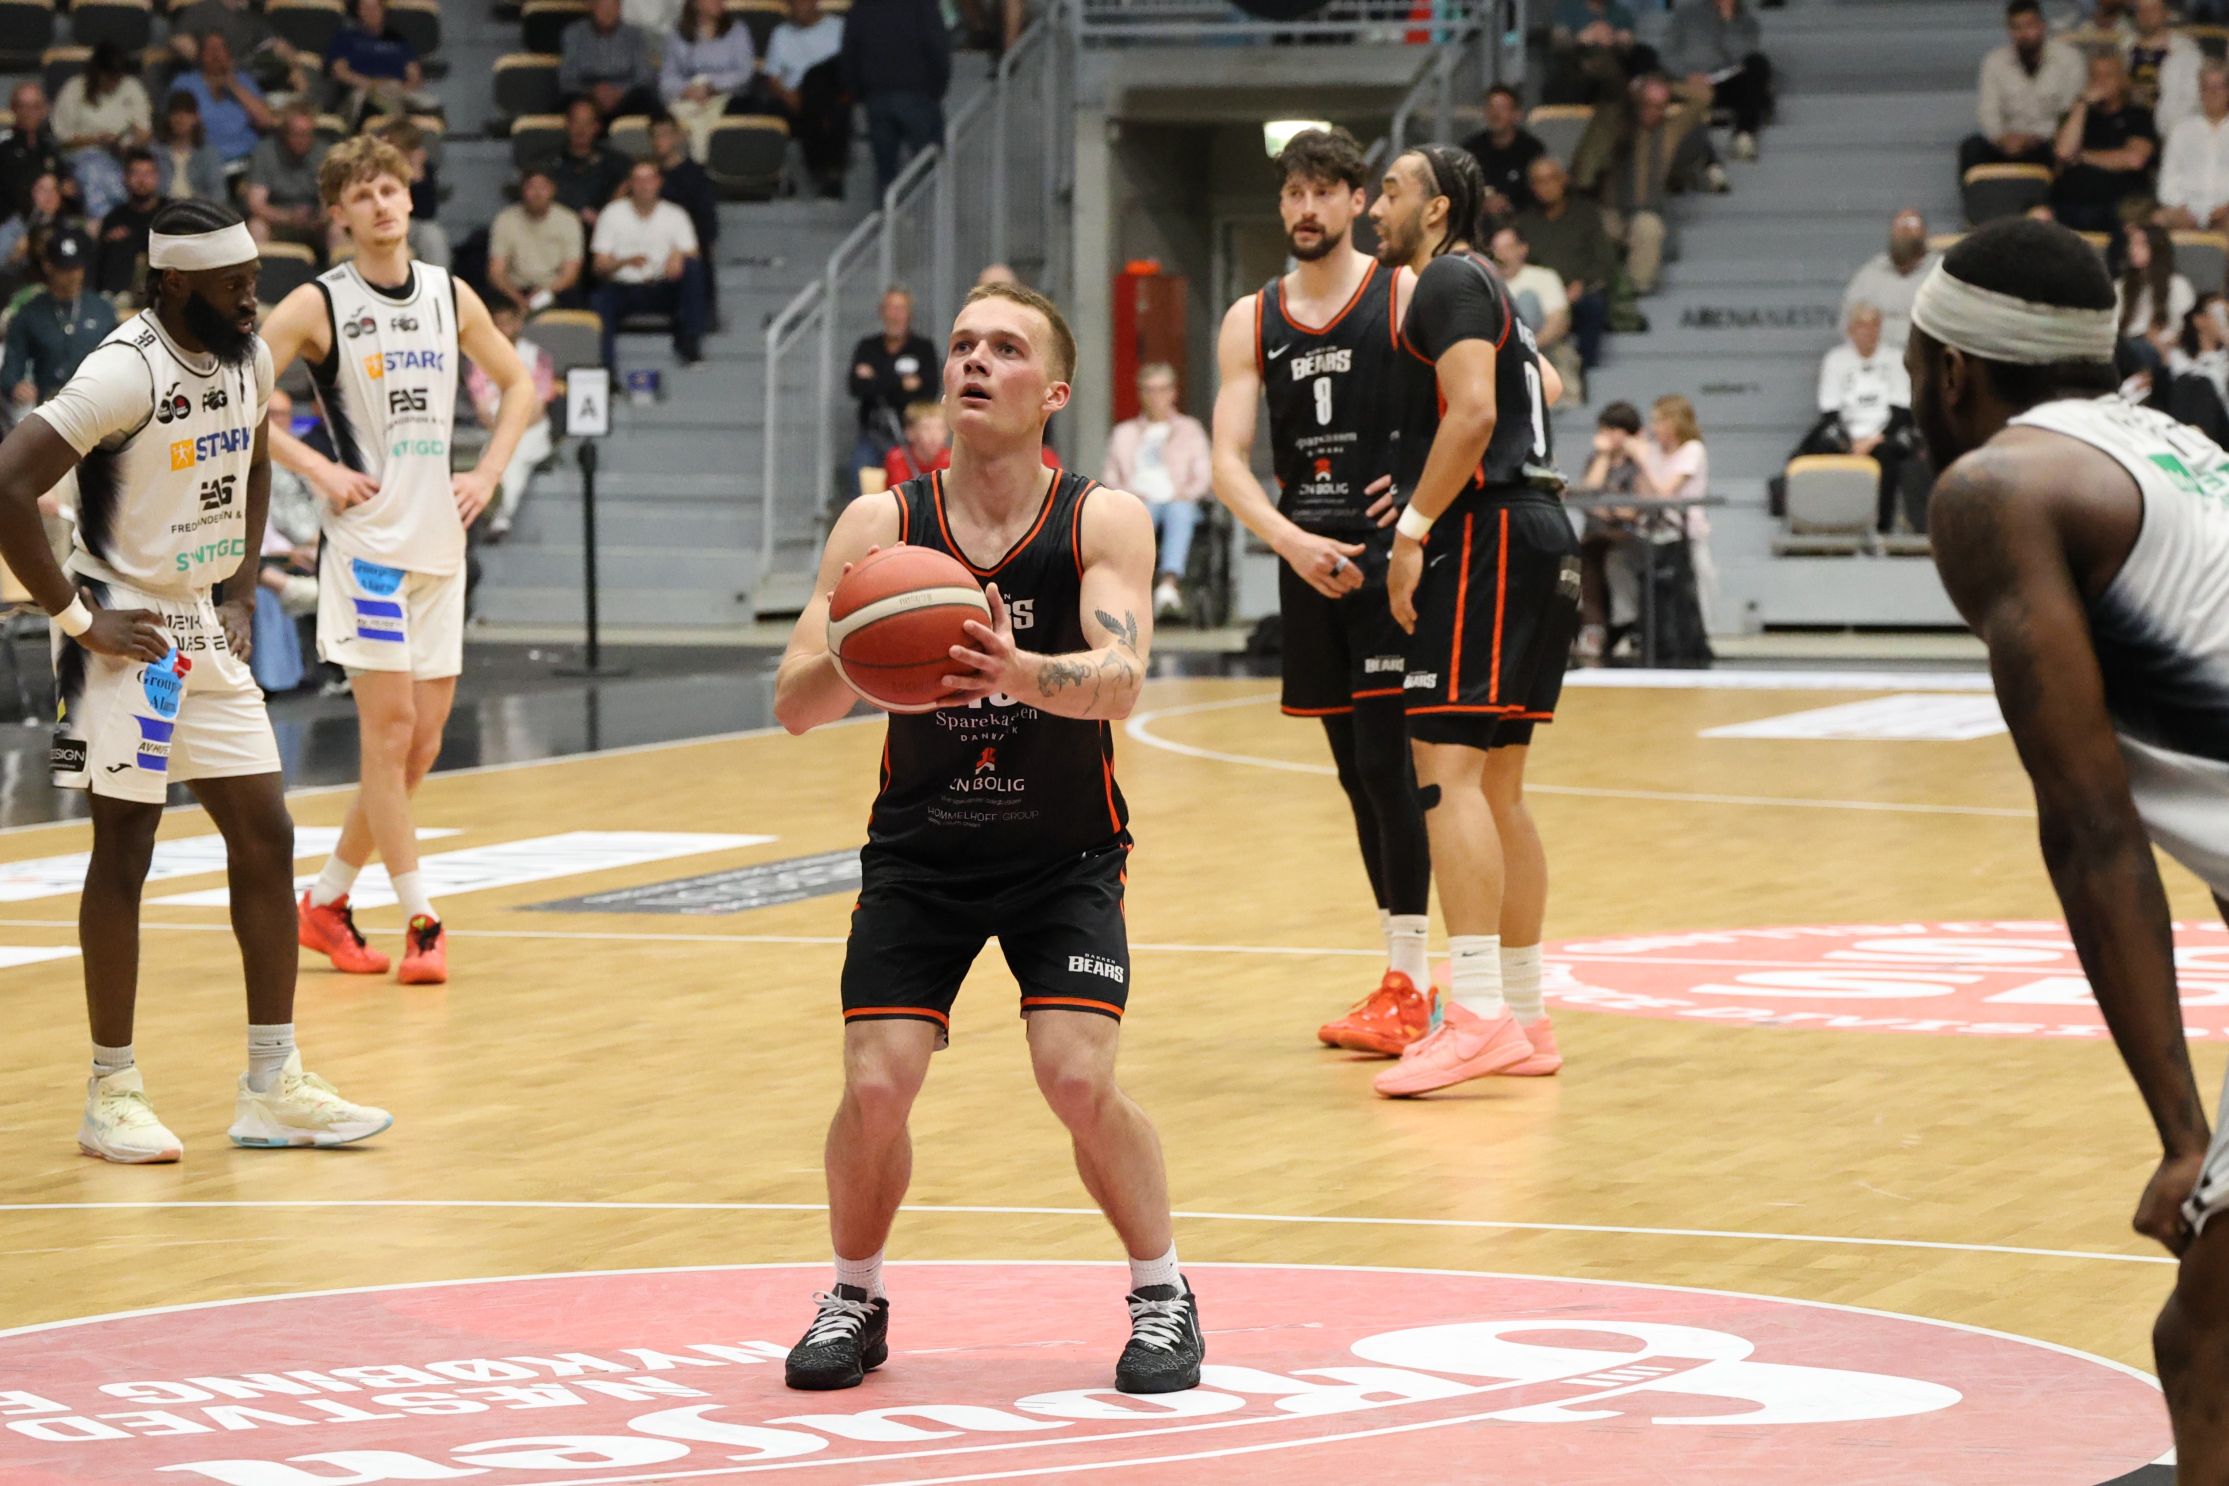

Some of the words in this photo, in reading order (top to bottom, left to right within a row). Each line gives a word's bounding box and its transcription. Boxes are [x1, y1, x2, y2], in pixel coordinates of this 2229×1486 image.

[1290, 349, 1352, 381] BEARS
[579, 397, 599, 418] A
[235, 511, 242, 519] &
[936, 708, 1038, 731] Sparekaen
[927, 806, 998, 822] HOMMELHOFF
[1002, 809, 1039, 821] GROUP
[1068, 955, 1124, 984] BEARS
[98, 1340, 789, 1404] NYKØBING
[5, 1376, 713, 1441] NÆSTVED
